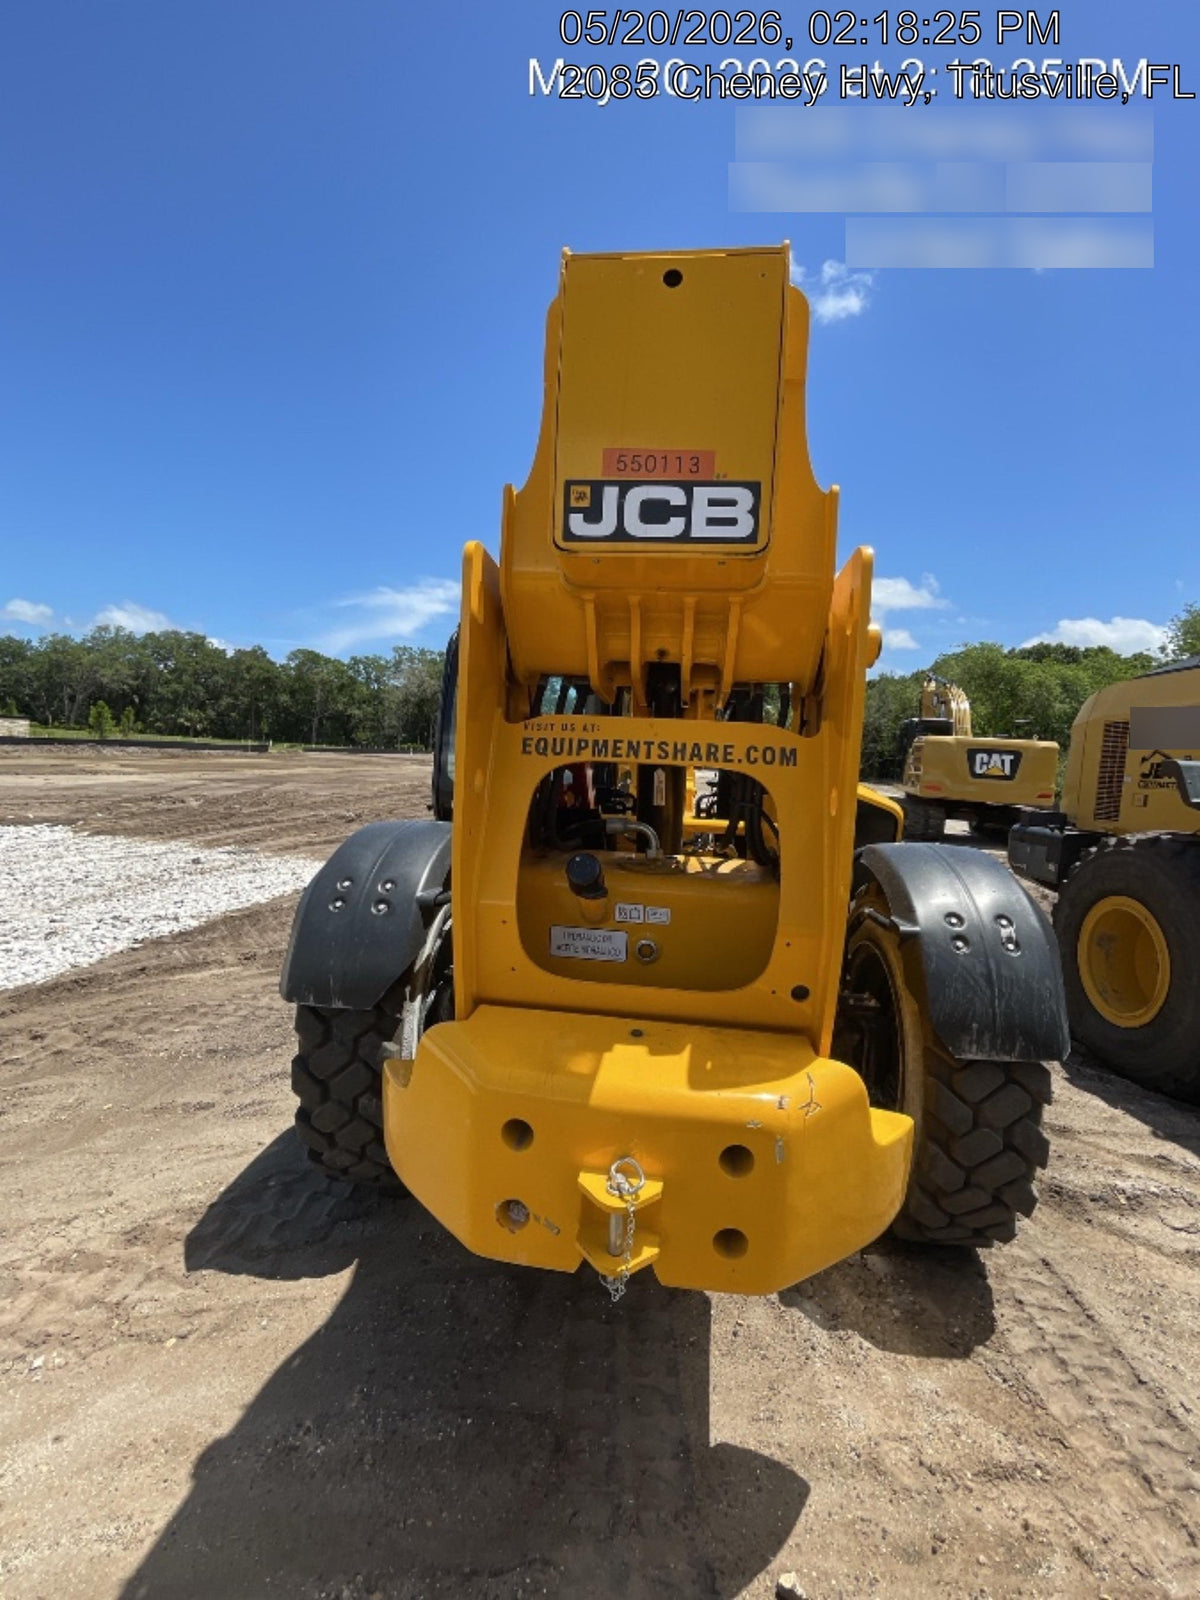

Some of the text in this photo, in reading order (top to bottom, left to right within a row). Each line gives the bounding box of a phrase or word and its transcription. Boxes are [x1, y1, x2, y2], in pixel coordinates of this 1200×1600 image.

[616, 453, 700, 474] 550113
[568, 485, 756, 539] JCB
[523, 721, 555, 732] VISIT
[561, 723, 576, 732] US
[521, 736, 798, 767] EQUIPMENTSHARE.COM
[974, 752, 1015, 776] CAT
